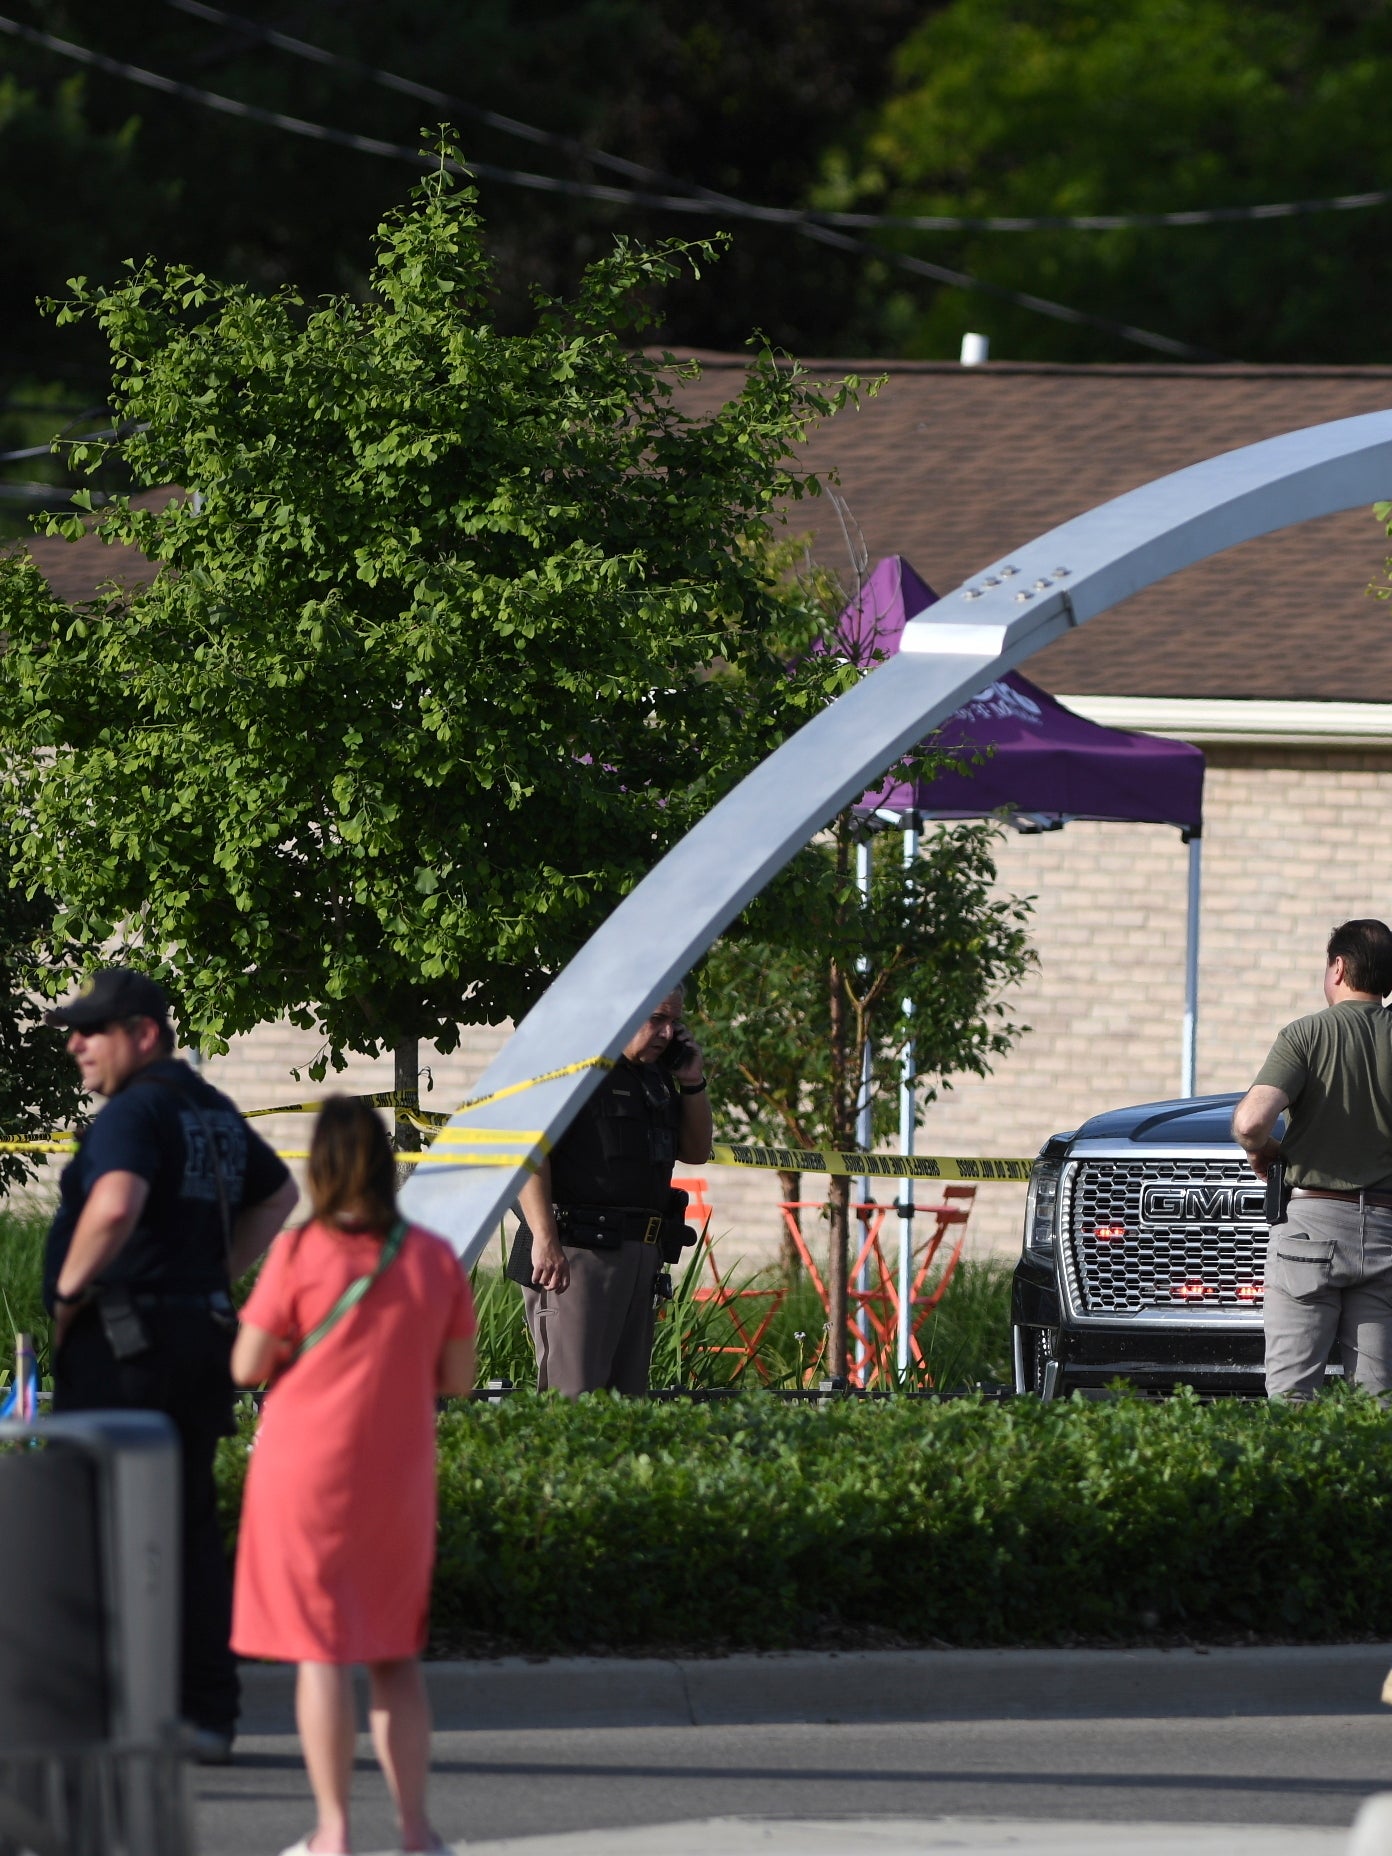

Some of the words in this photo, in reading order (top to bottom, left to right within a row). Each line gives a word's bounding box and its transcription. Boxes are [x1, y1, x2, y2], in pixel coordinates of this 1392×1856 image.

[842, 1155, 866, 1173] CROSS
[864, 1155, 881, 1174] NOT
[878, 1156, 891, 1174] DO
[889, 1156, 908, 1176] LINE
[956, 1160, 979, 1178] CROSS
[978, 1159, 995, 1178] NOT
[993, 1159, 1006, 1178] DO
[1144, 1188, 1267, 1219] GMC
